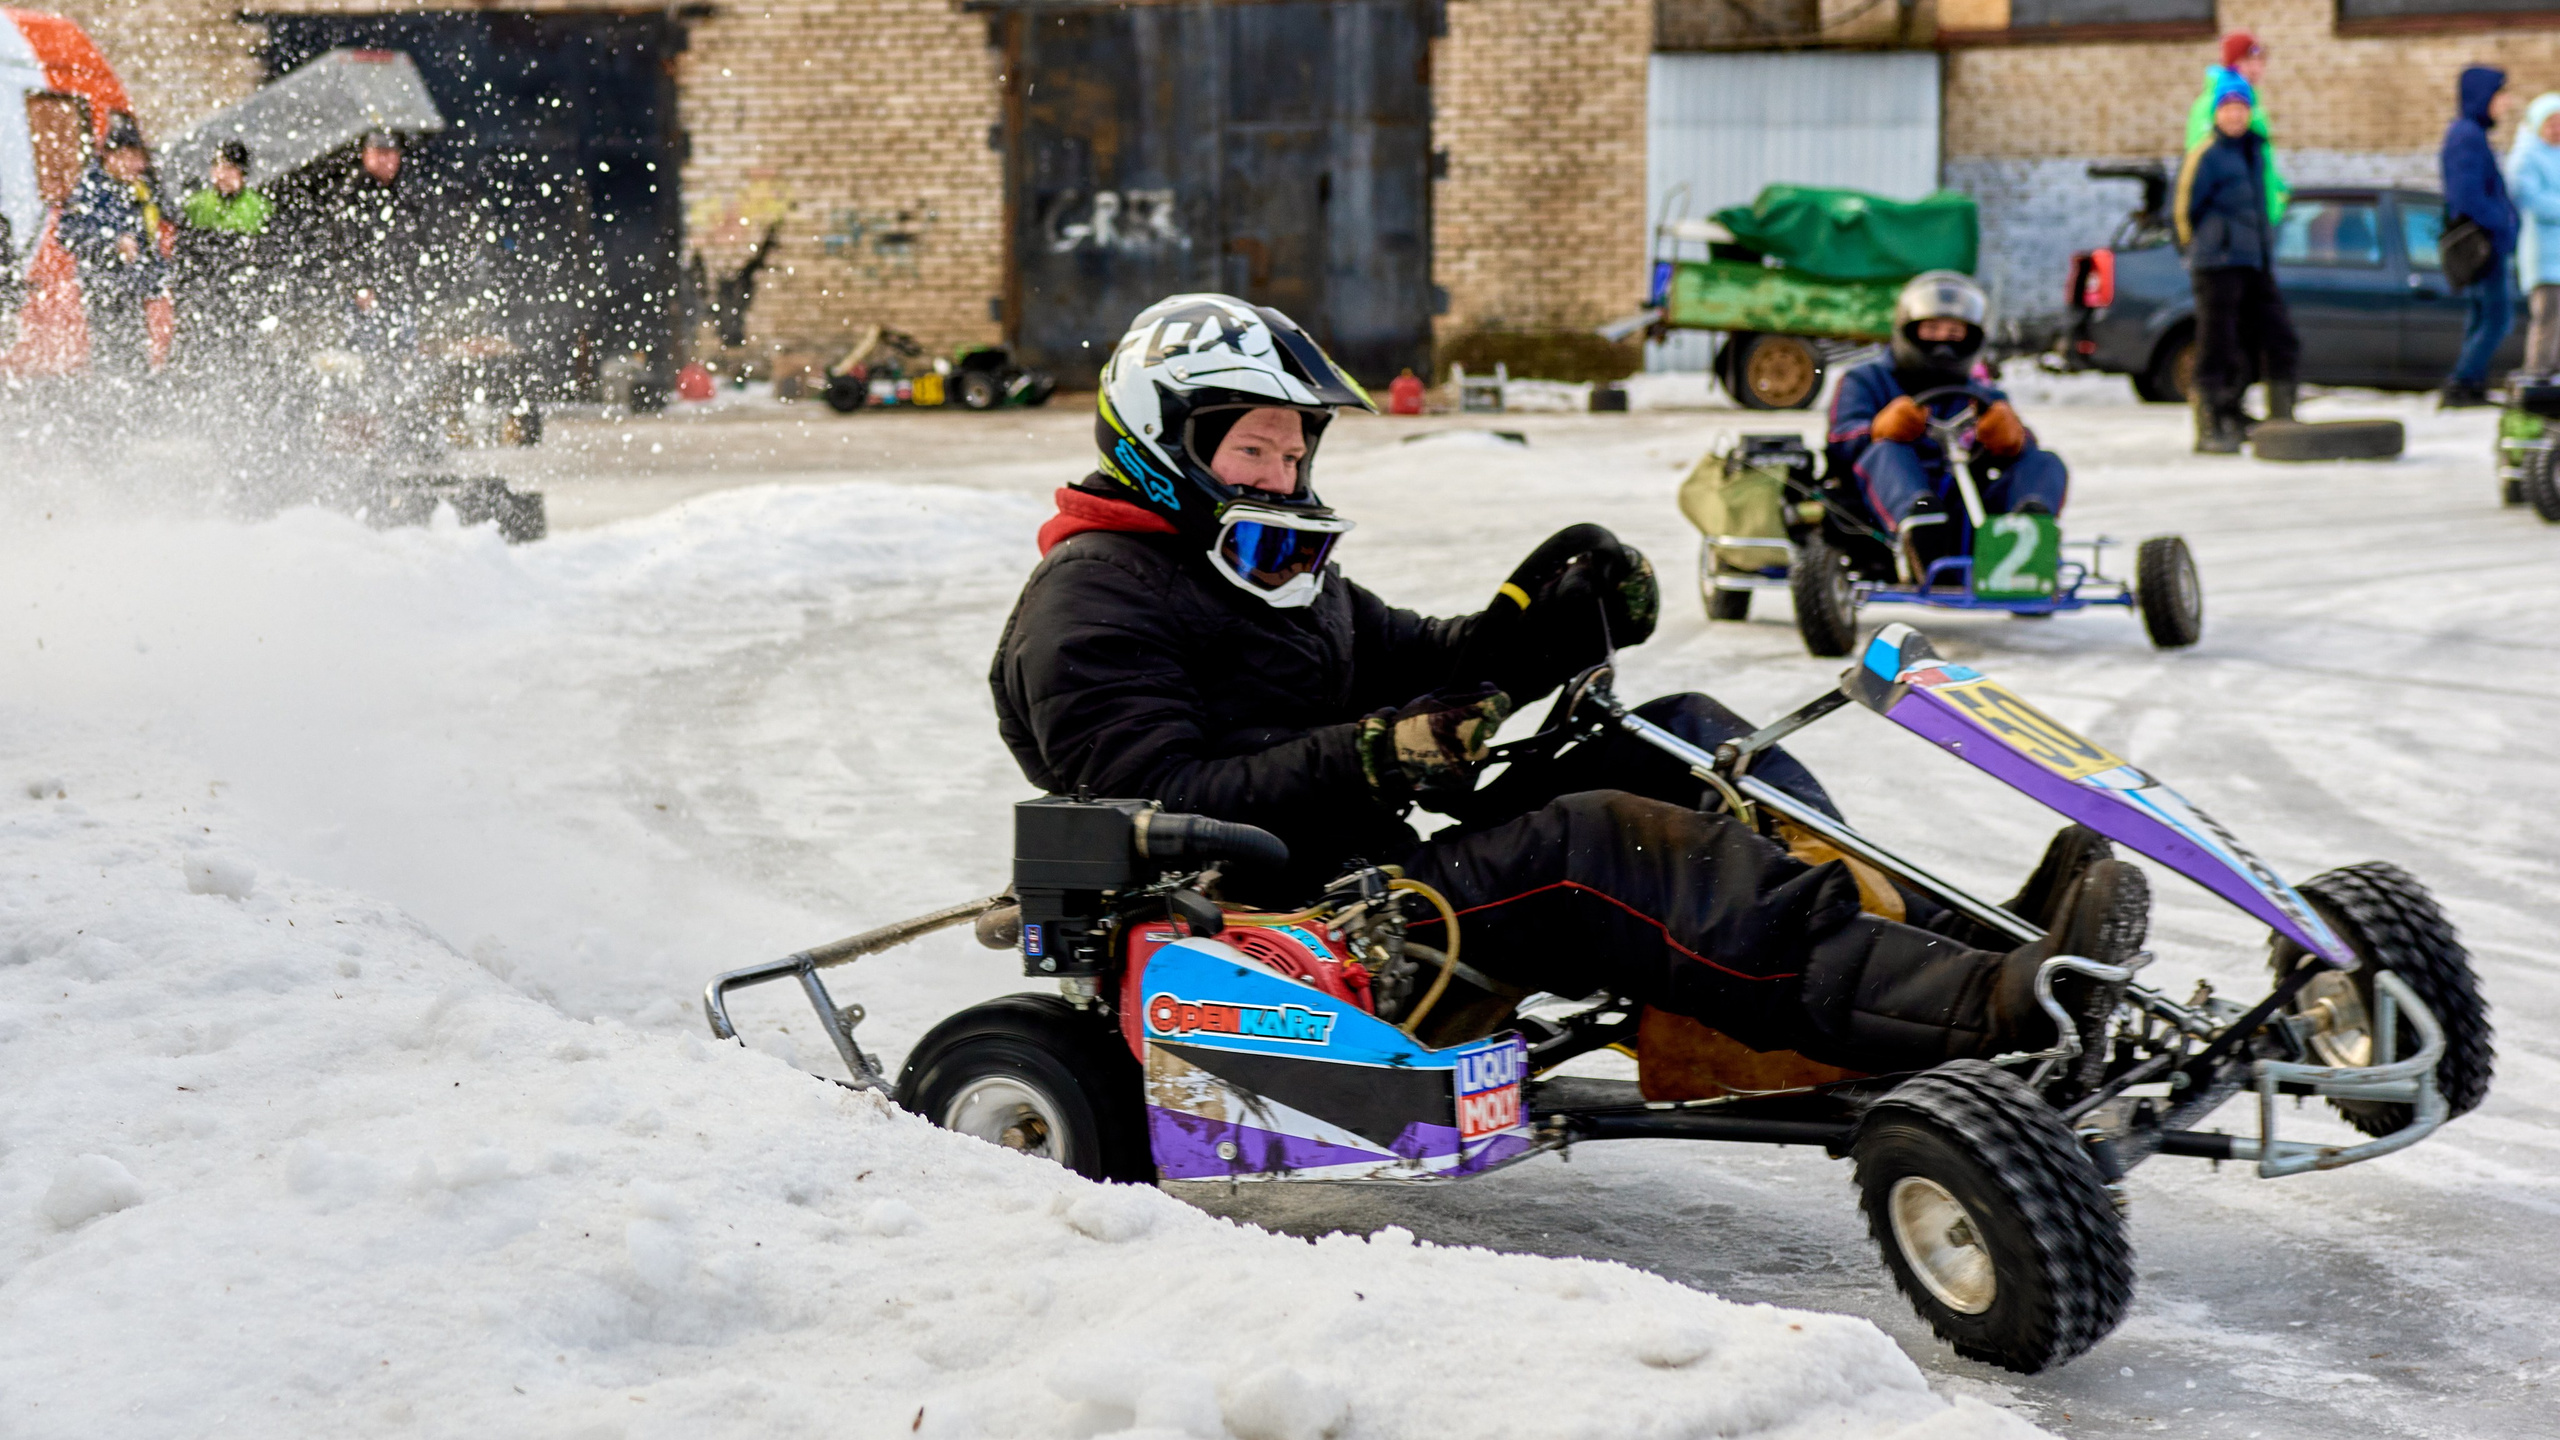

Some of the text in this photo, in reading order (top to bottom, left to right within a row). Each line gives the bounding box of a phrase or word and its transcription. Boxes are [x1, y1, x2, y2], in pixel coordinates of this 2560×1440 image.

[1988, 513, 2040, 593] 2
[1944, 685, 2104, 768] 50
[1461, 1086, 1519, 1134] MOLY
